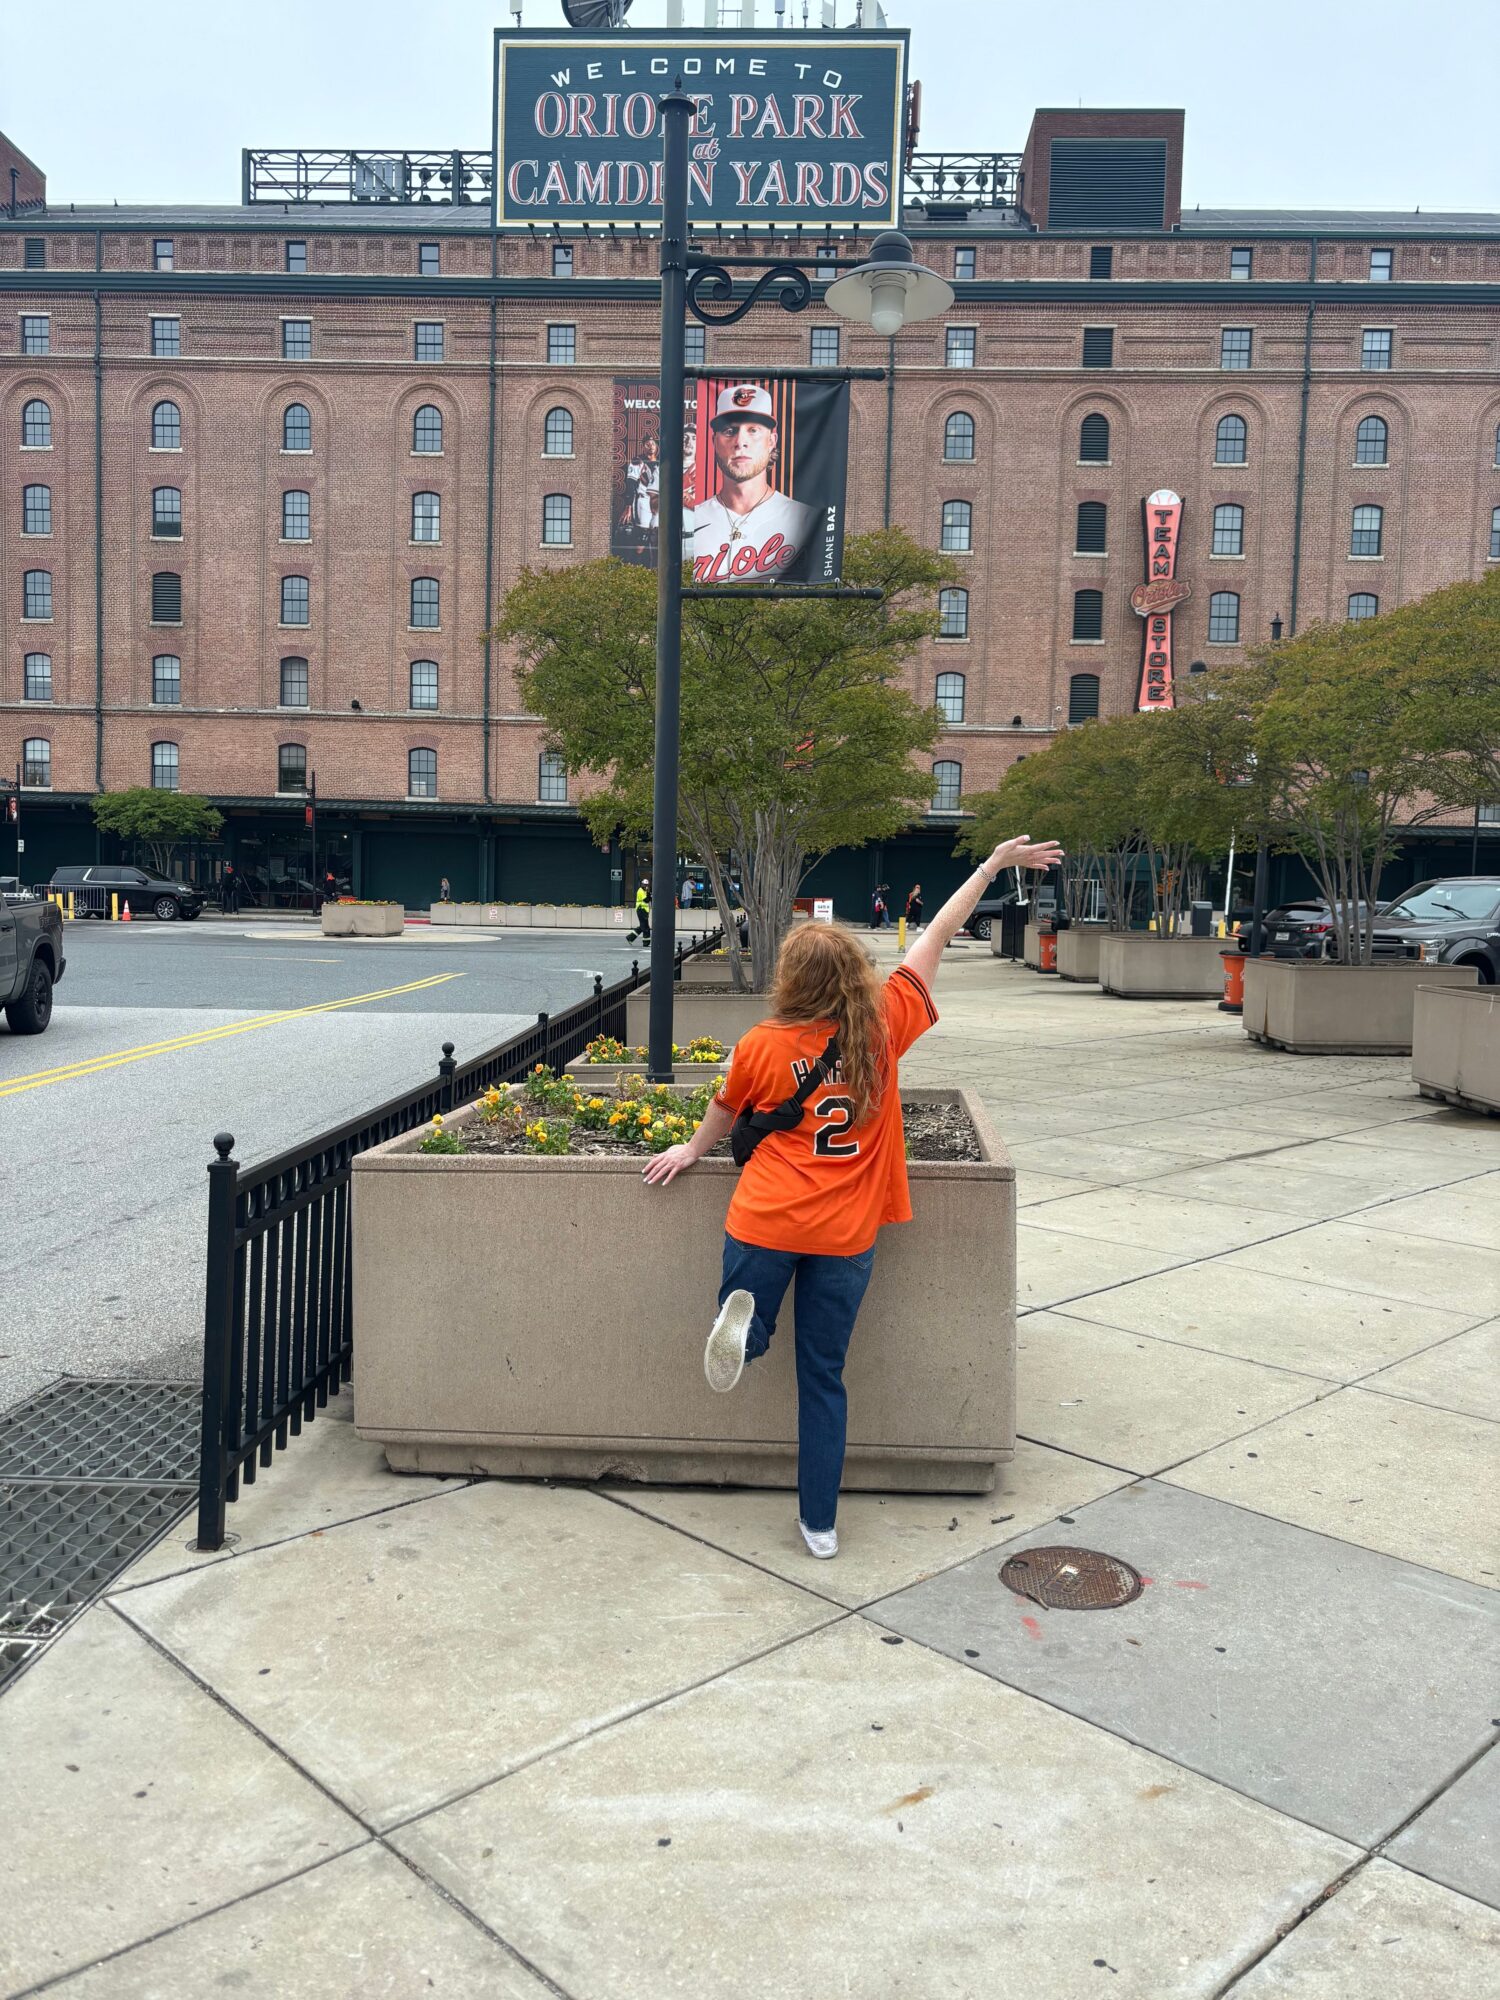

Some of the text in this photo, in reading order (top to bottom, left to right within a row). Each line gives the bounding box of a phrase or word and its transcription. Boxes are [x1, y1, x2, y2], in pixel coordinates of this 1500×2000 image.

[550, 57, 842, 89] WELCOME TO
[534, 91, 865, 139] ORIOE PARK
[692, 138, 720, 161] at
[729, 159, 889, 209] YARDS
[693, 533, 800, 582] riole
[824, 505, 836, 576] SHANE BAZ
[1153, 509, 1173, 576] TEAM
[1148, 618, 1167, 701] STORE
[813, 1095, 860, 1157] 2
